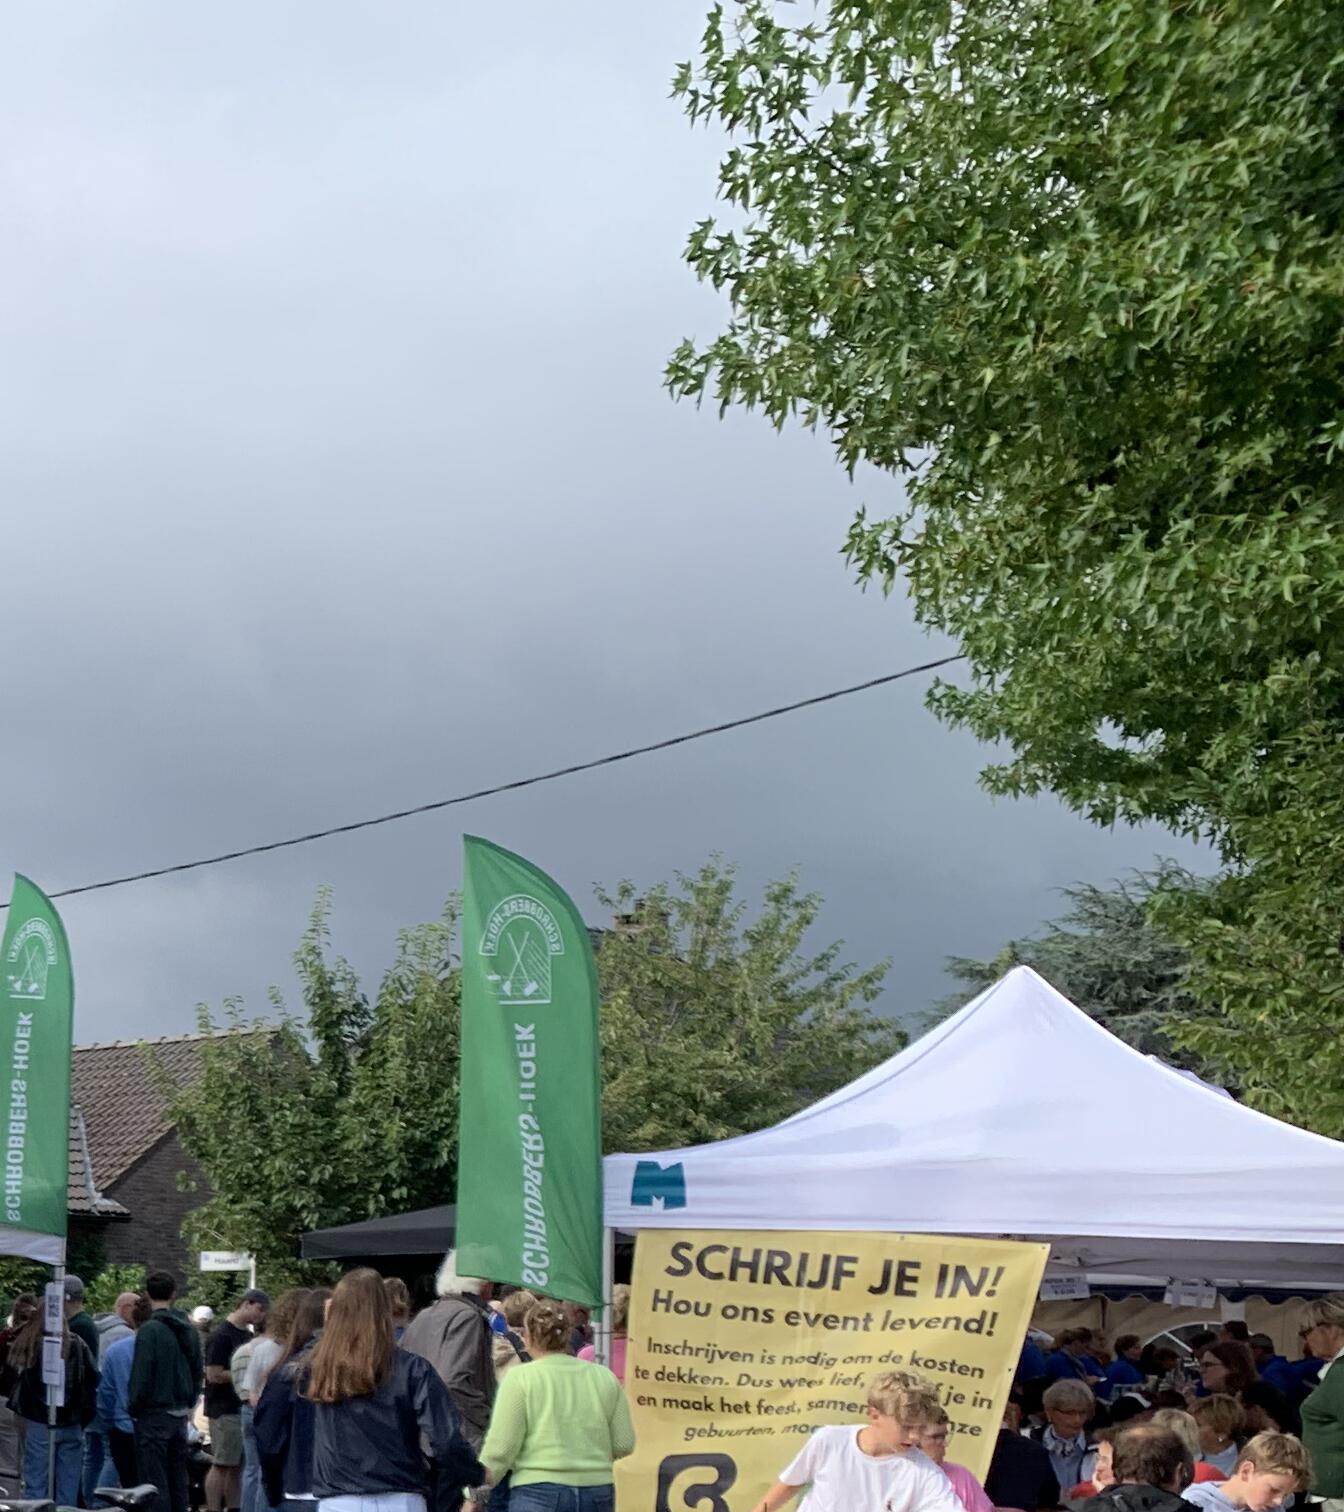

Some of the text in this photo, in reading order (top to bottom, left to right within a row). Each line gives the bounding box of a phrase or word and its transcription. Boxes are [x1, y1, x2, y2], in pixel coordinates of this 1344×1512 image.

[665, 1240, 859, 1292] SCHRIJF
[867, 1258, 923, 1299] JE
[934, 1264, 1008, 1299] IN!
[651, 1289, 999, 1337] Hou ons event levend!
[647, 1336, 985, 1379] Inschrijven is nodig om de kosten
[634, 1365, 651, 1380] te
[654, 1365, 730, 1387] dekken.
[736, 1373, 774, 1388] Dus
[778, 1376, 824, 1389] wees
[830, 1371, 865, 1388] lief,
[943, 1385, 966, 1406] je
[971, 1391, 994, 1410] in
[636, 1393, 658, 1408] en
[662, 1395, 715, 1413] maak
[720, 1396, 752, 1415] het
[756, 1400, 802, 1417] feest,
[946, 1420, 983, 1437] nze
[682, 1422, 777, 1442] gebuurten,
